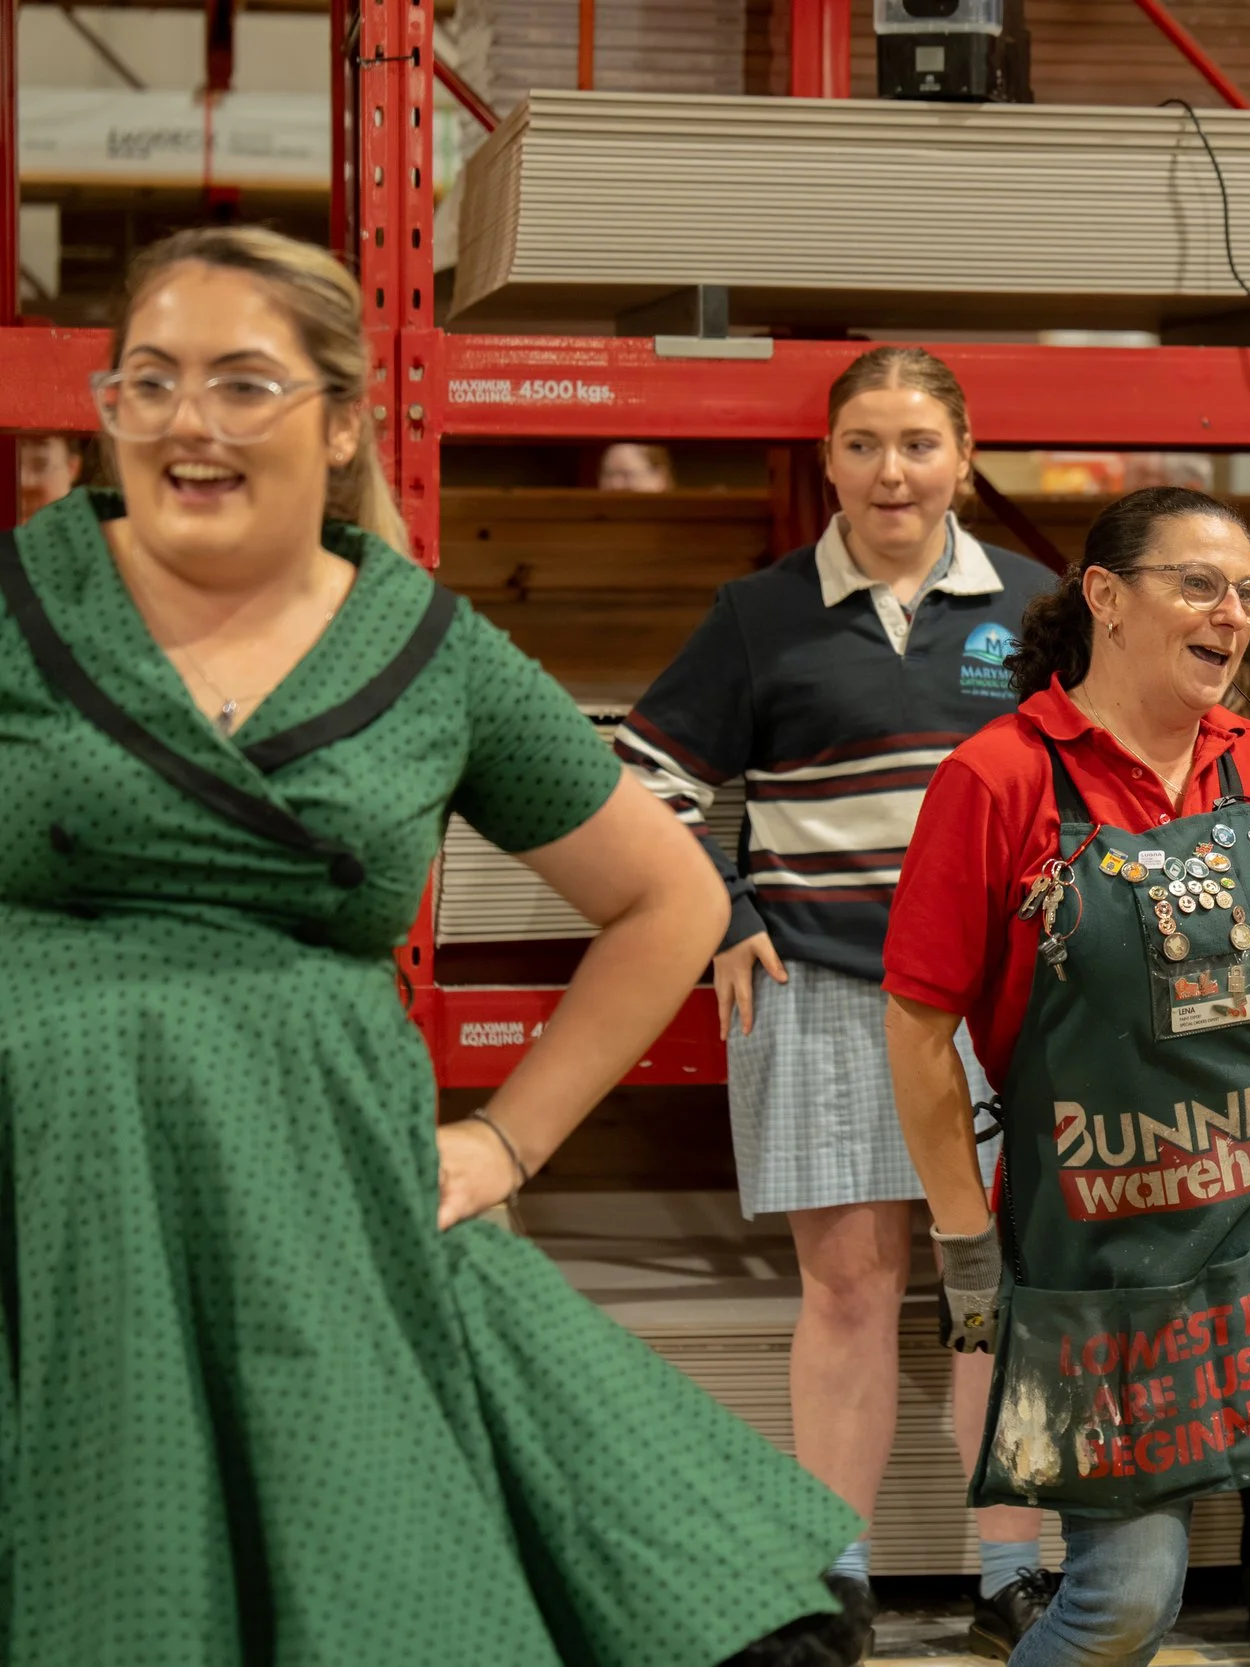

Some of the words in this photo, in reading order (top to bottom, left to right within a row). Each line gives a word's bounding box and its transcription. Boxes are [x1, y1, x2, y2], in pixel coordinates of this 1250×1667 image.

[449, 380, 511, 391] MAXIMUM
[519, 380, 573, 399] 4500
[1178, 1006, 1196, 1016] LENA
[460, 1022, 524, 1033] MAXIMUM
[460, 1033, 525, 1046] LOADING
[1060, 1304, 1233, 1377] LOWEST
[1085, 1375, 1179, 1428] ARE
